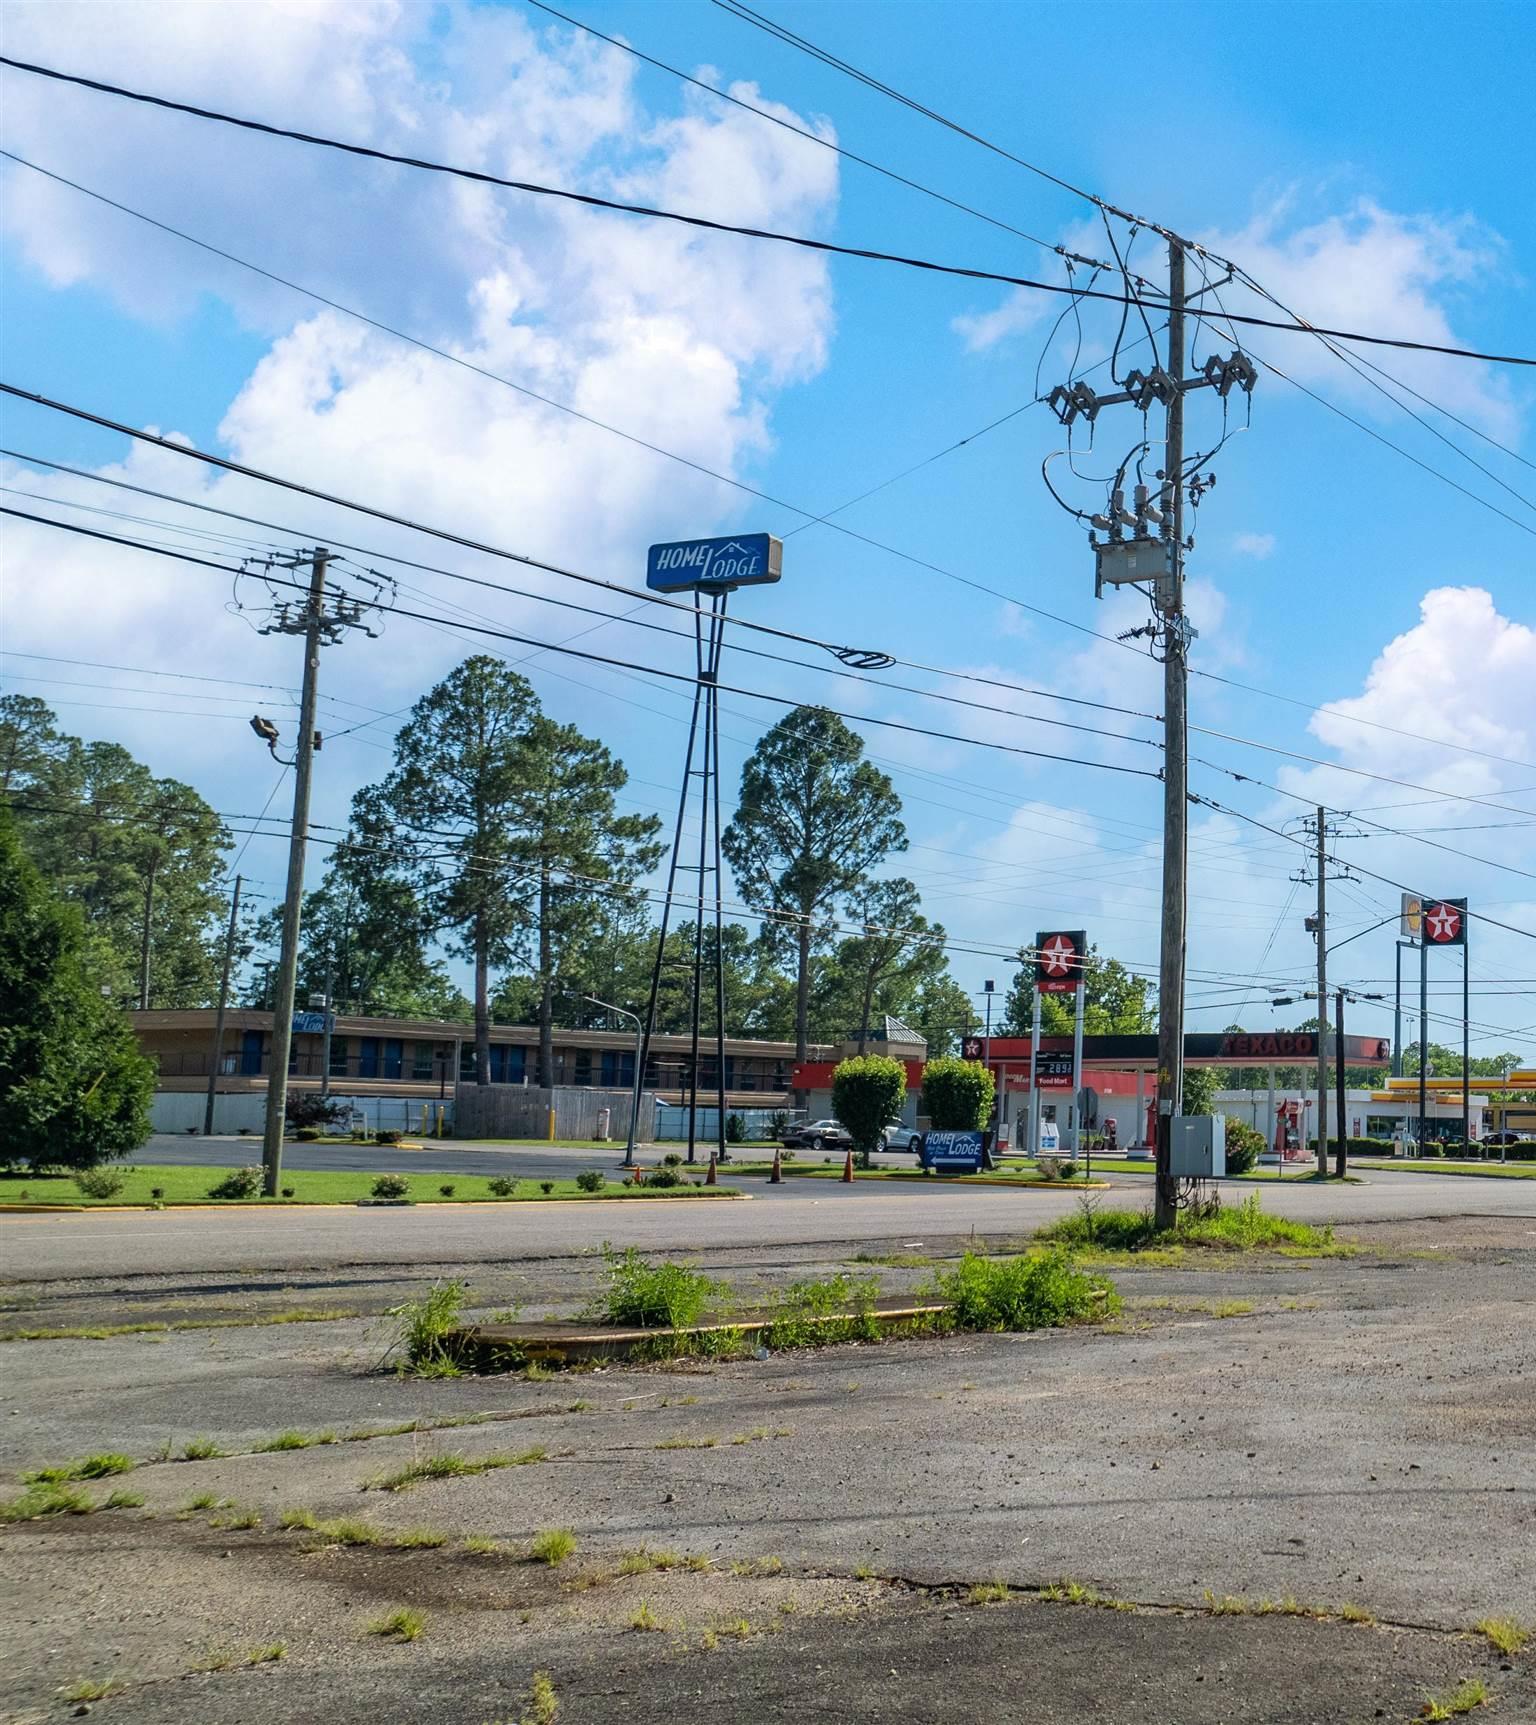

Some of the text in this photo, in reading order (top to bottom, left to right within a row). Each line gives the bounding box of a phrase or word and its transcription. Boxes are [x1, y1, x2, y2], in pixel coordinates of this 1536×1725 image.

[656, 545, 761, 579] HOME LODGE
[1223, 1035, 1313, 1054] TEXACO
[926, 1133, 953, 1144] HOME
[949, 1134, 981, 1155] LODGE
